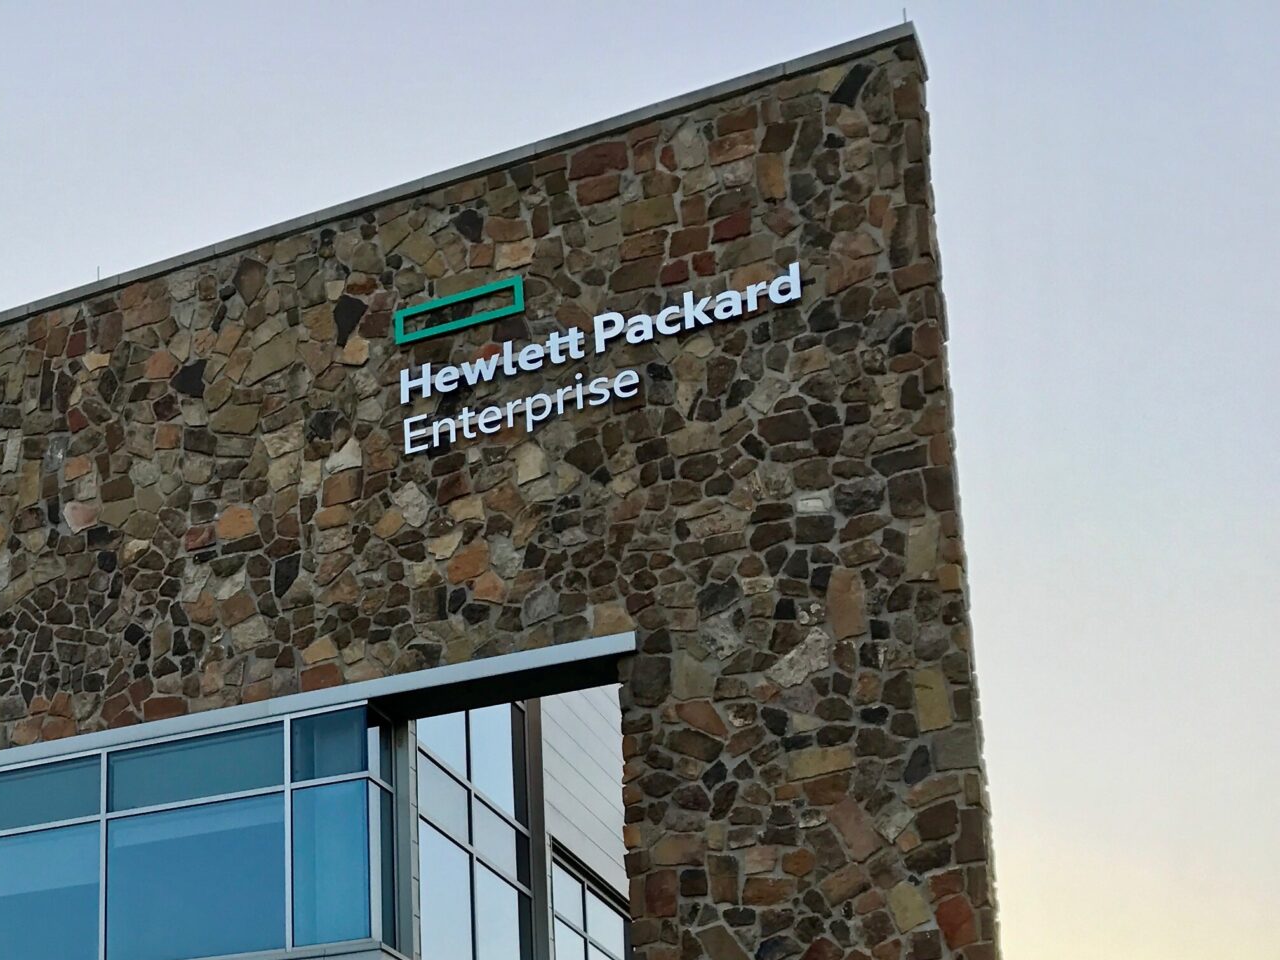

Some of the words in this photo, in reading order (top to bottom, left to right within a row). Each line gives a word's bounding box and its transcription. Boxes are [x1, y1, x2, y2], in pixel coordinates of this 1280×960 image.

[400, 326, 585, 404] Hewlett
[594, 262, 801, 353] Packard
[403, 369, 640, 454] Enterprise
